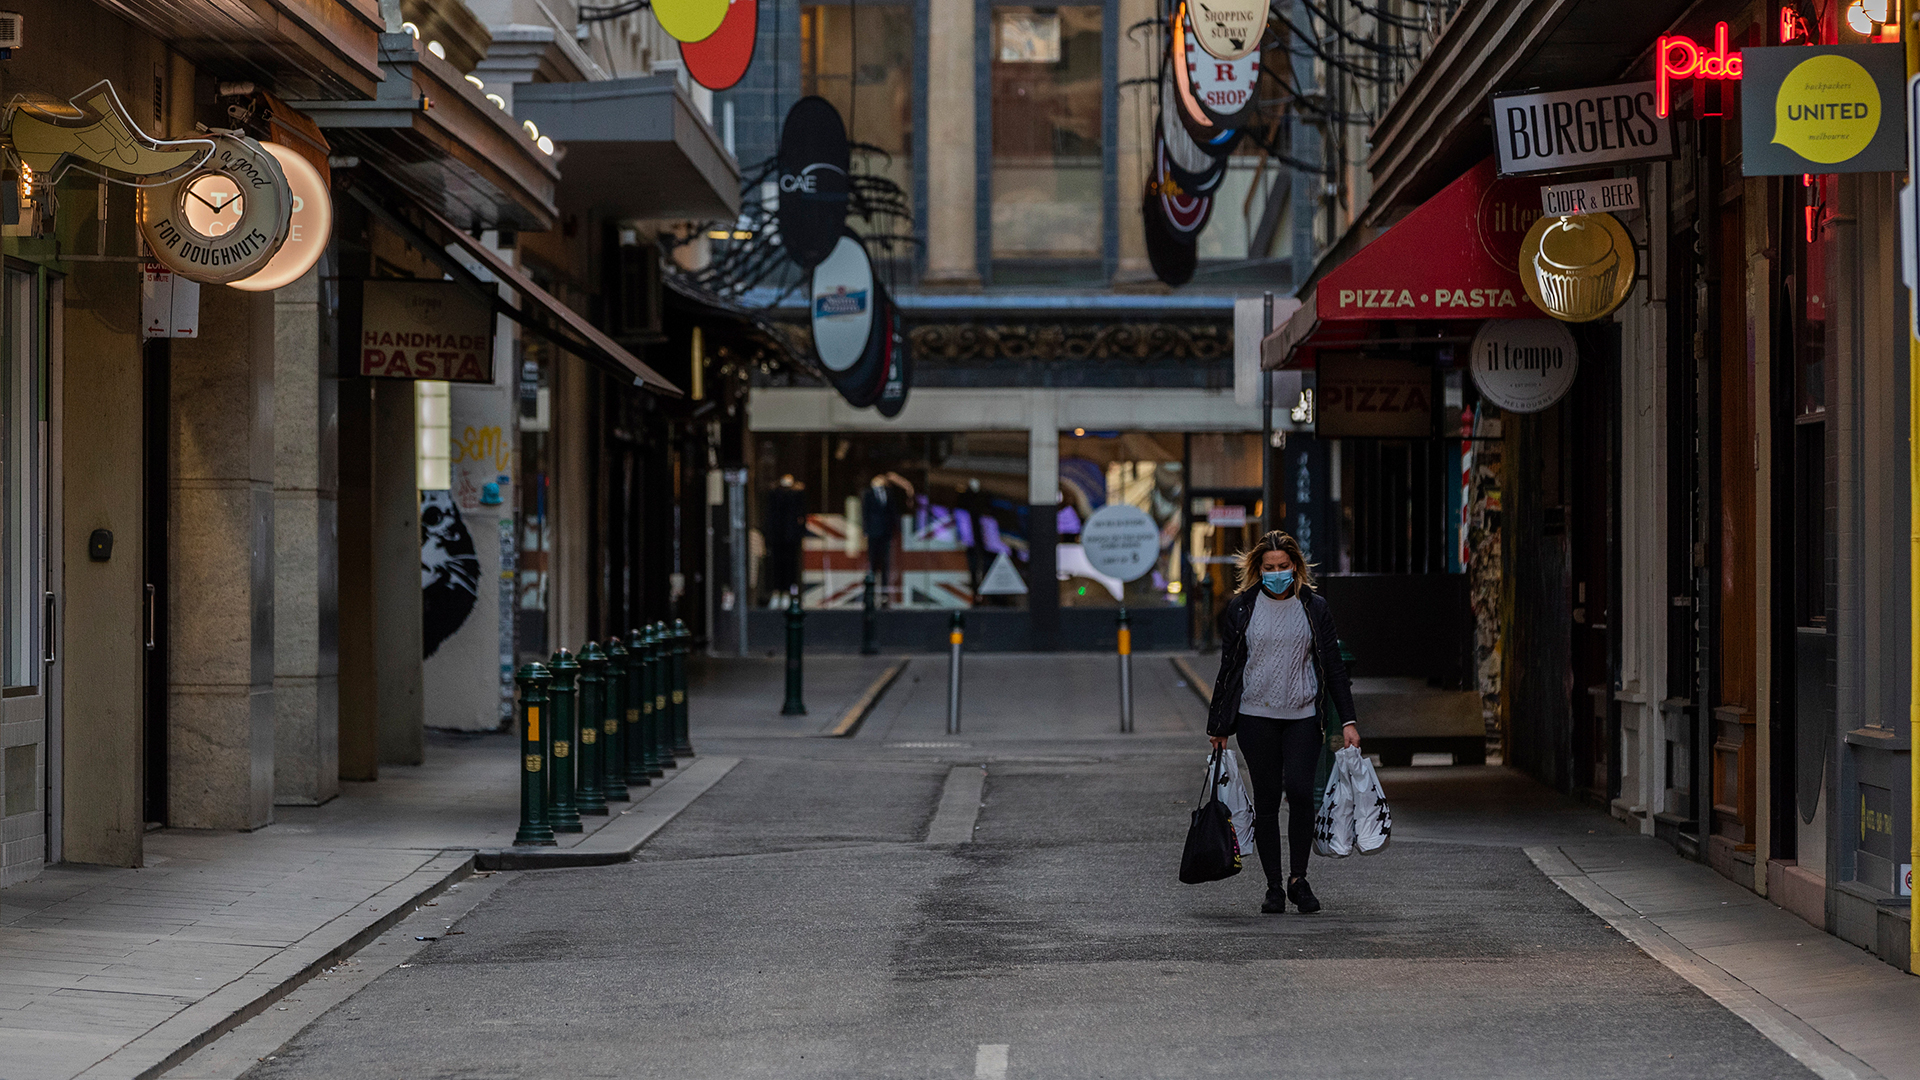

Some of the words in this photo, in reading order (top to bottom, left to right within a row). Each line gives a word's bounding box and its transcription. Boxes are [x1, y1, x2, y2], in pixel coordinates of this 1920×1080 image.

[1205, 10, 1254, 22] SHOPPING
[1212, 27, 1248, 39] SUBWAY
[1805, 82, 1851, 92] backpackers
[1206, 89, 1247, 106] SHOP
[1788, 102, 1869, 121] UNITED
[1506, 91, 1659, 160] BURGERS
[1808, 132, 1850, 142] melbourne
[230, 158, 272, 189] good
[780, 174, 817, 194] CAE
[1547, 188, 1587, 214] CIDER
[1590, 195, 1599, 209] &
[1601, 183, 1635, 208] BEER
[154, 218, 181, 249] FOR
[180, 229, 267, 266] DOUGHNUTS
[1340, 289, 1416, 308] PIZZA
[1435, 289, 1517, 308] PASTA
[364, 331, 486, 350] HANDMADE
[363, 349, 482, 381] PASTA
[1487, 342, 1499, 371] il
[1503, 341, 1563, 377] tempo
[1320, 386, 1429, 411] PIZZA
[1504, 395, 1553, 409] MELBOURNE
